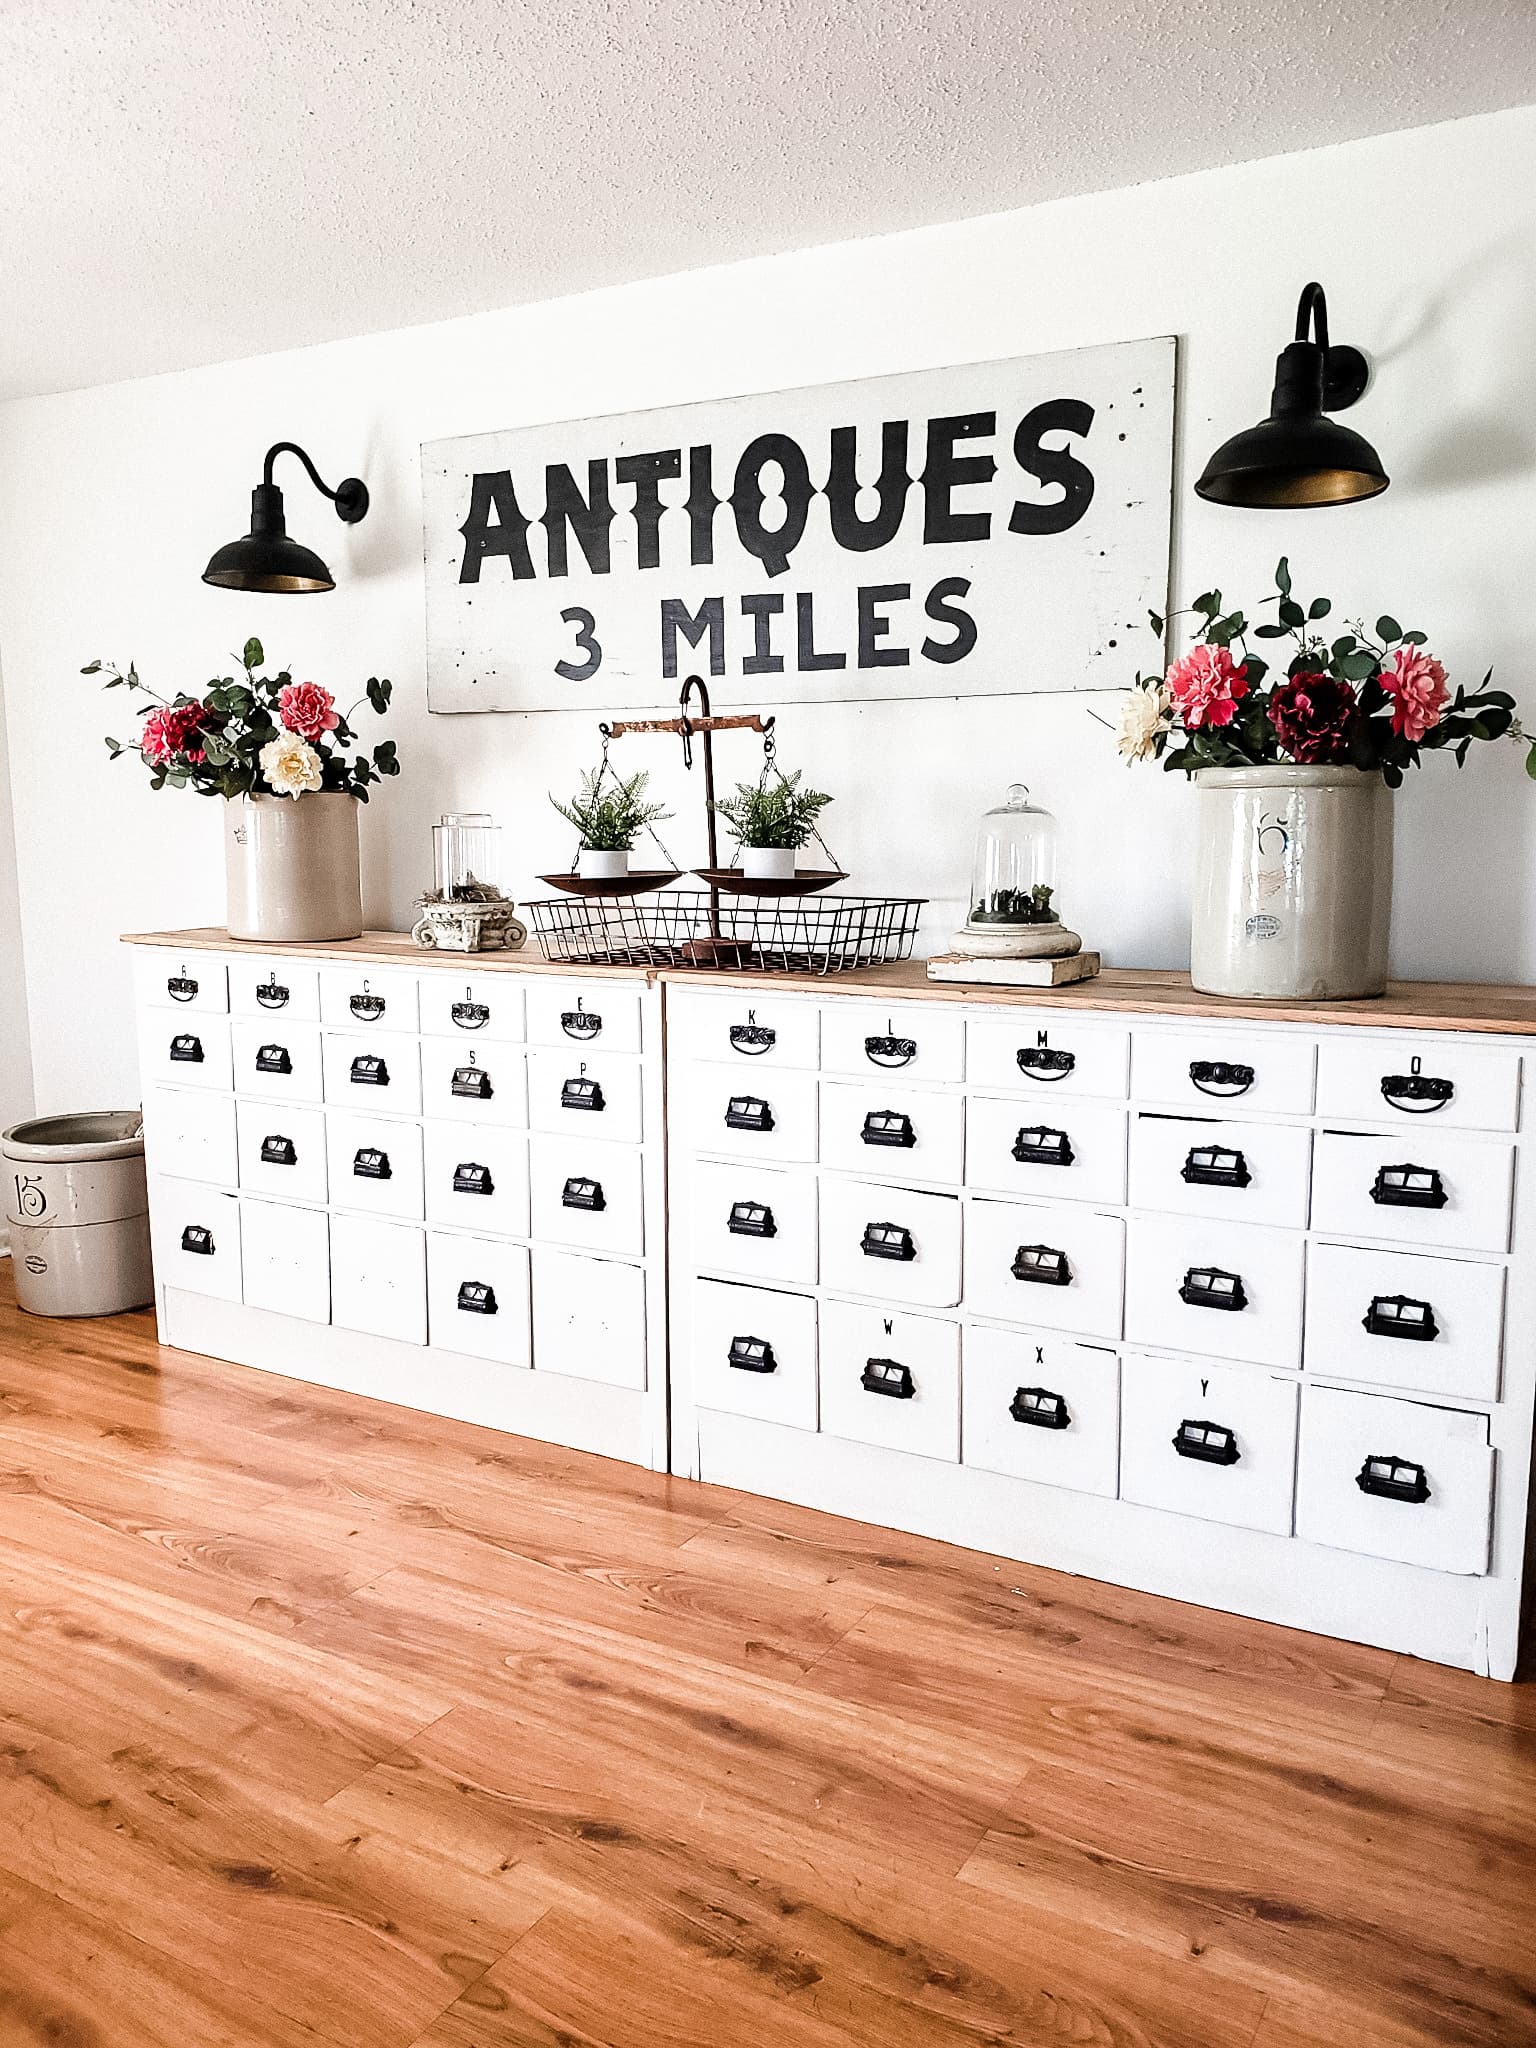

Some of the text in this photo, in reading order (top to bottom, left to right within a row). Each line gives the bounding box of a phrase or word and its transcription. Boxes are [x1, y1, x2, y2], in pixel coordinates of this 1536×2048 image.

[459, 399, 1095, 583] ANTIQUES
[554, 577, 978, 681] 3 MILES
[363, 979, 370, 994] C
[466, 986, 472, 1001] D
[577, 996, 584, 1011] E
[748, 1009, 756, 1025] K
[888, 1018, 894, 1036] L
[1037, 1029, 1048, 1048] M
[469, 1050, 476, 1065] S
[580, 1062, 587, 1076] P
[14, 1174, 47, 1218] 15
[883, 1318, 894, 1336] W
[1035, 1346, 1044, 1364] X
[1200, 1378, 1210, 1398] Y
